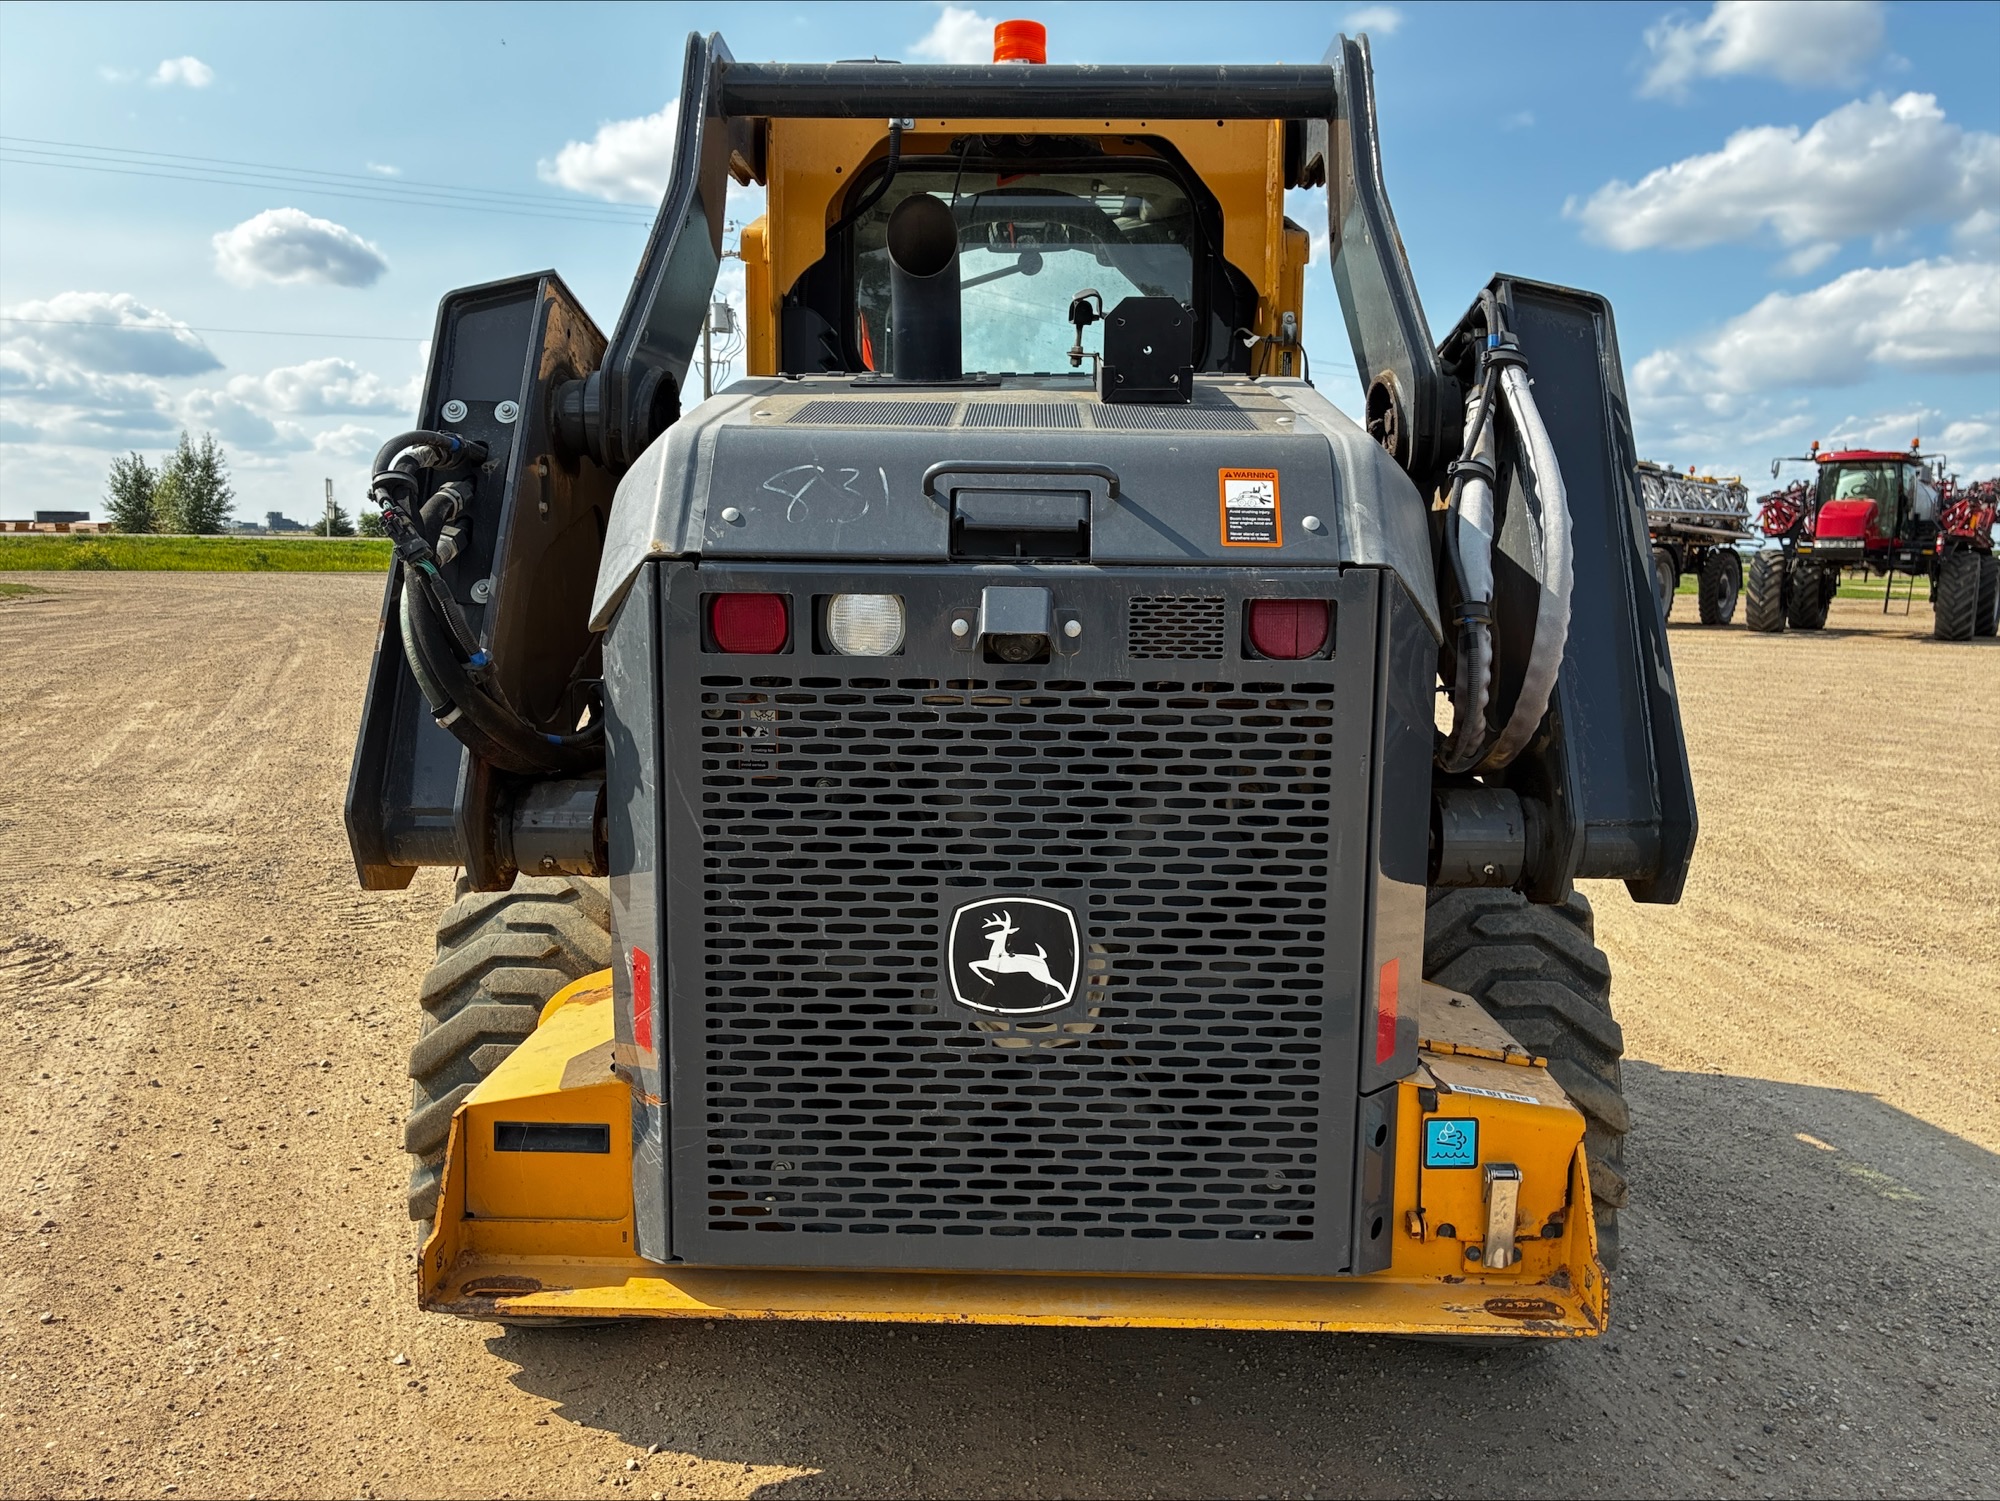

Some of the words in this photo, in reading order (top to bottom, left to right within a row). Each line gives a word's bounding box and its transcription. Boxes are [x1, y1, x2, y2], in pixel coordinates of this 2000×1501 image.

[1233, 471, 1275, 479] WARNING
[763, 464, 889, 523] 831
[1454, 1085, 1484, 1095] Check
[1504, 1093, 1530, 1102] Level
